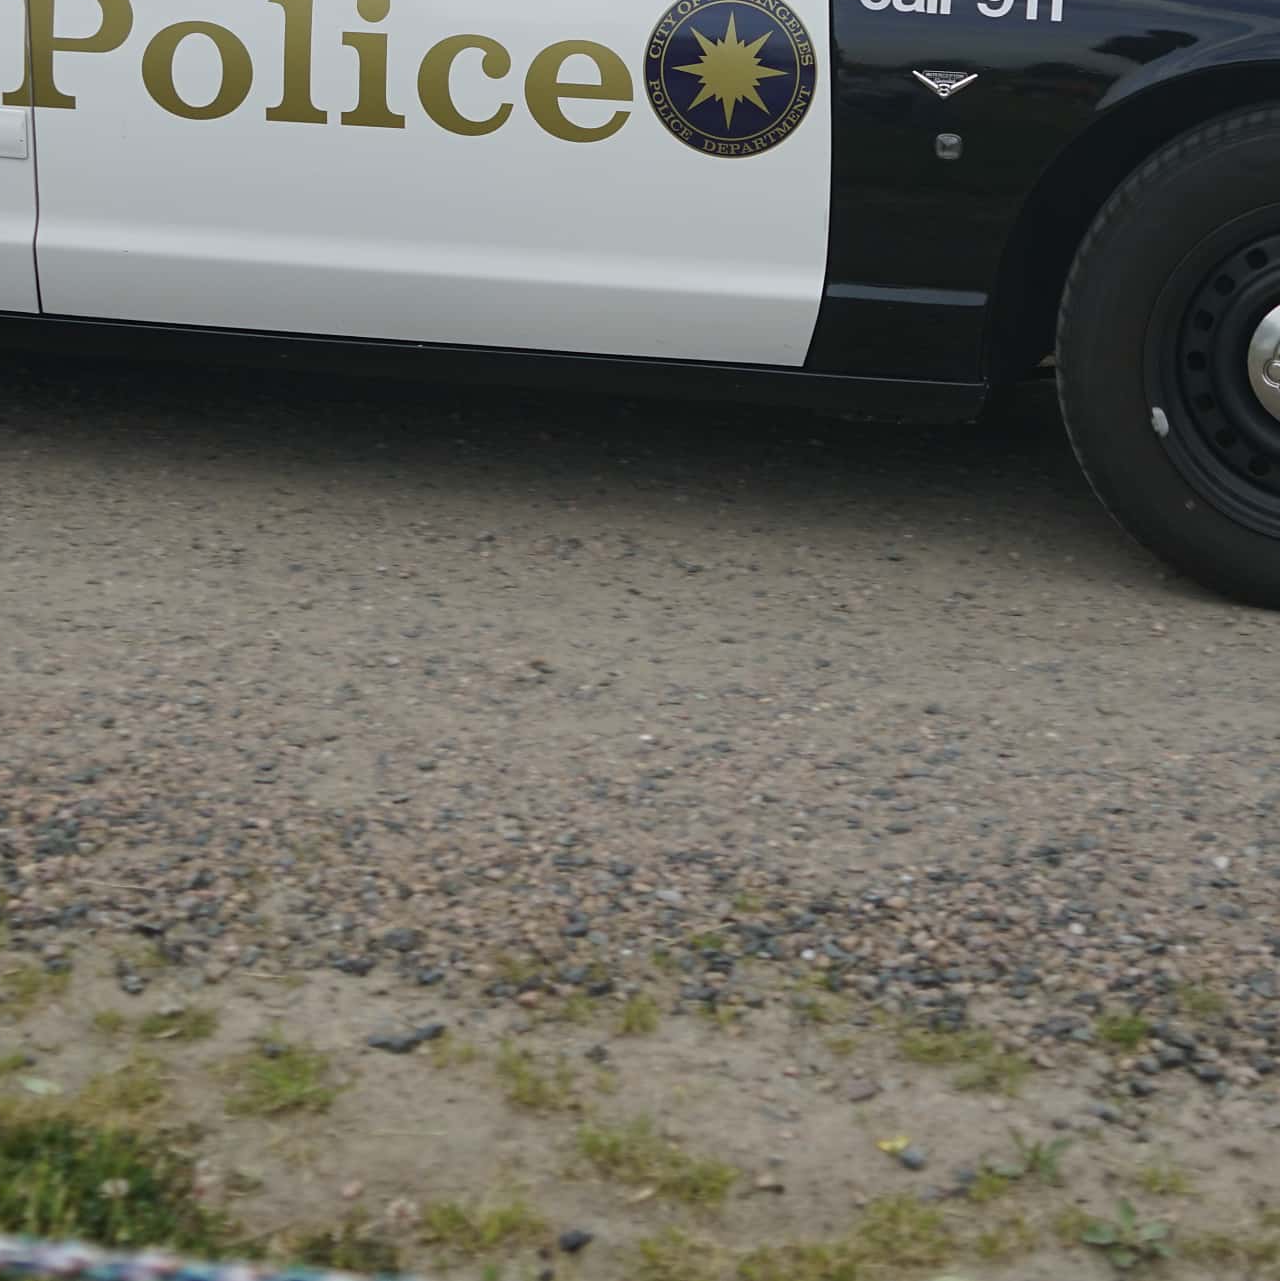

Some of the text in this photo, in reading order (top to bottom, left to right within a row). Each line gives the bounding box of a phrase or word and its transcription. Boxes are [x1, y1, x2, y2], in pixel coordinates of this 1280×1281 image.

[649, 14, 675, 60] CITY
[649, 79, 812, 155] POLICE DEPARTMENT
